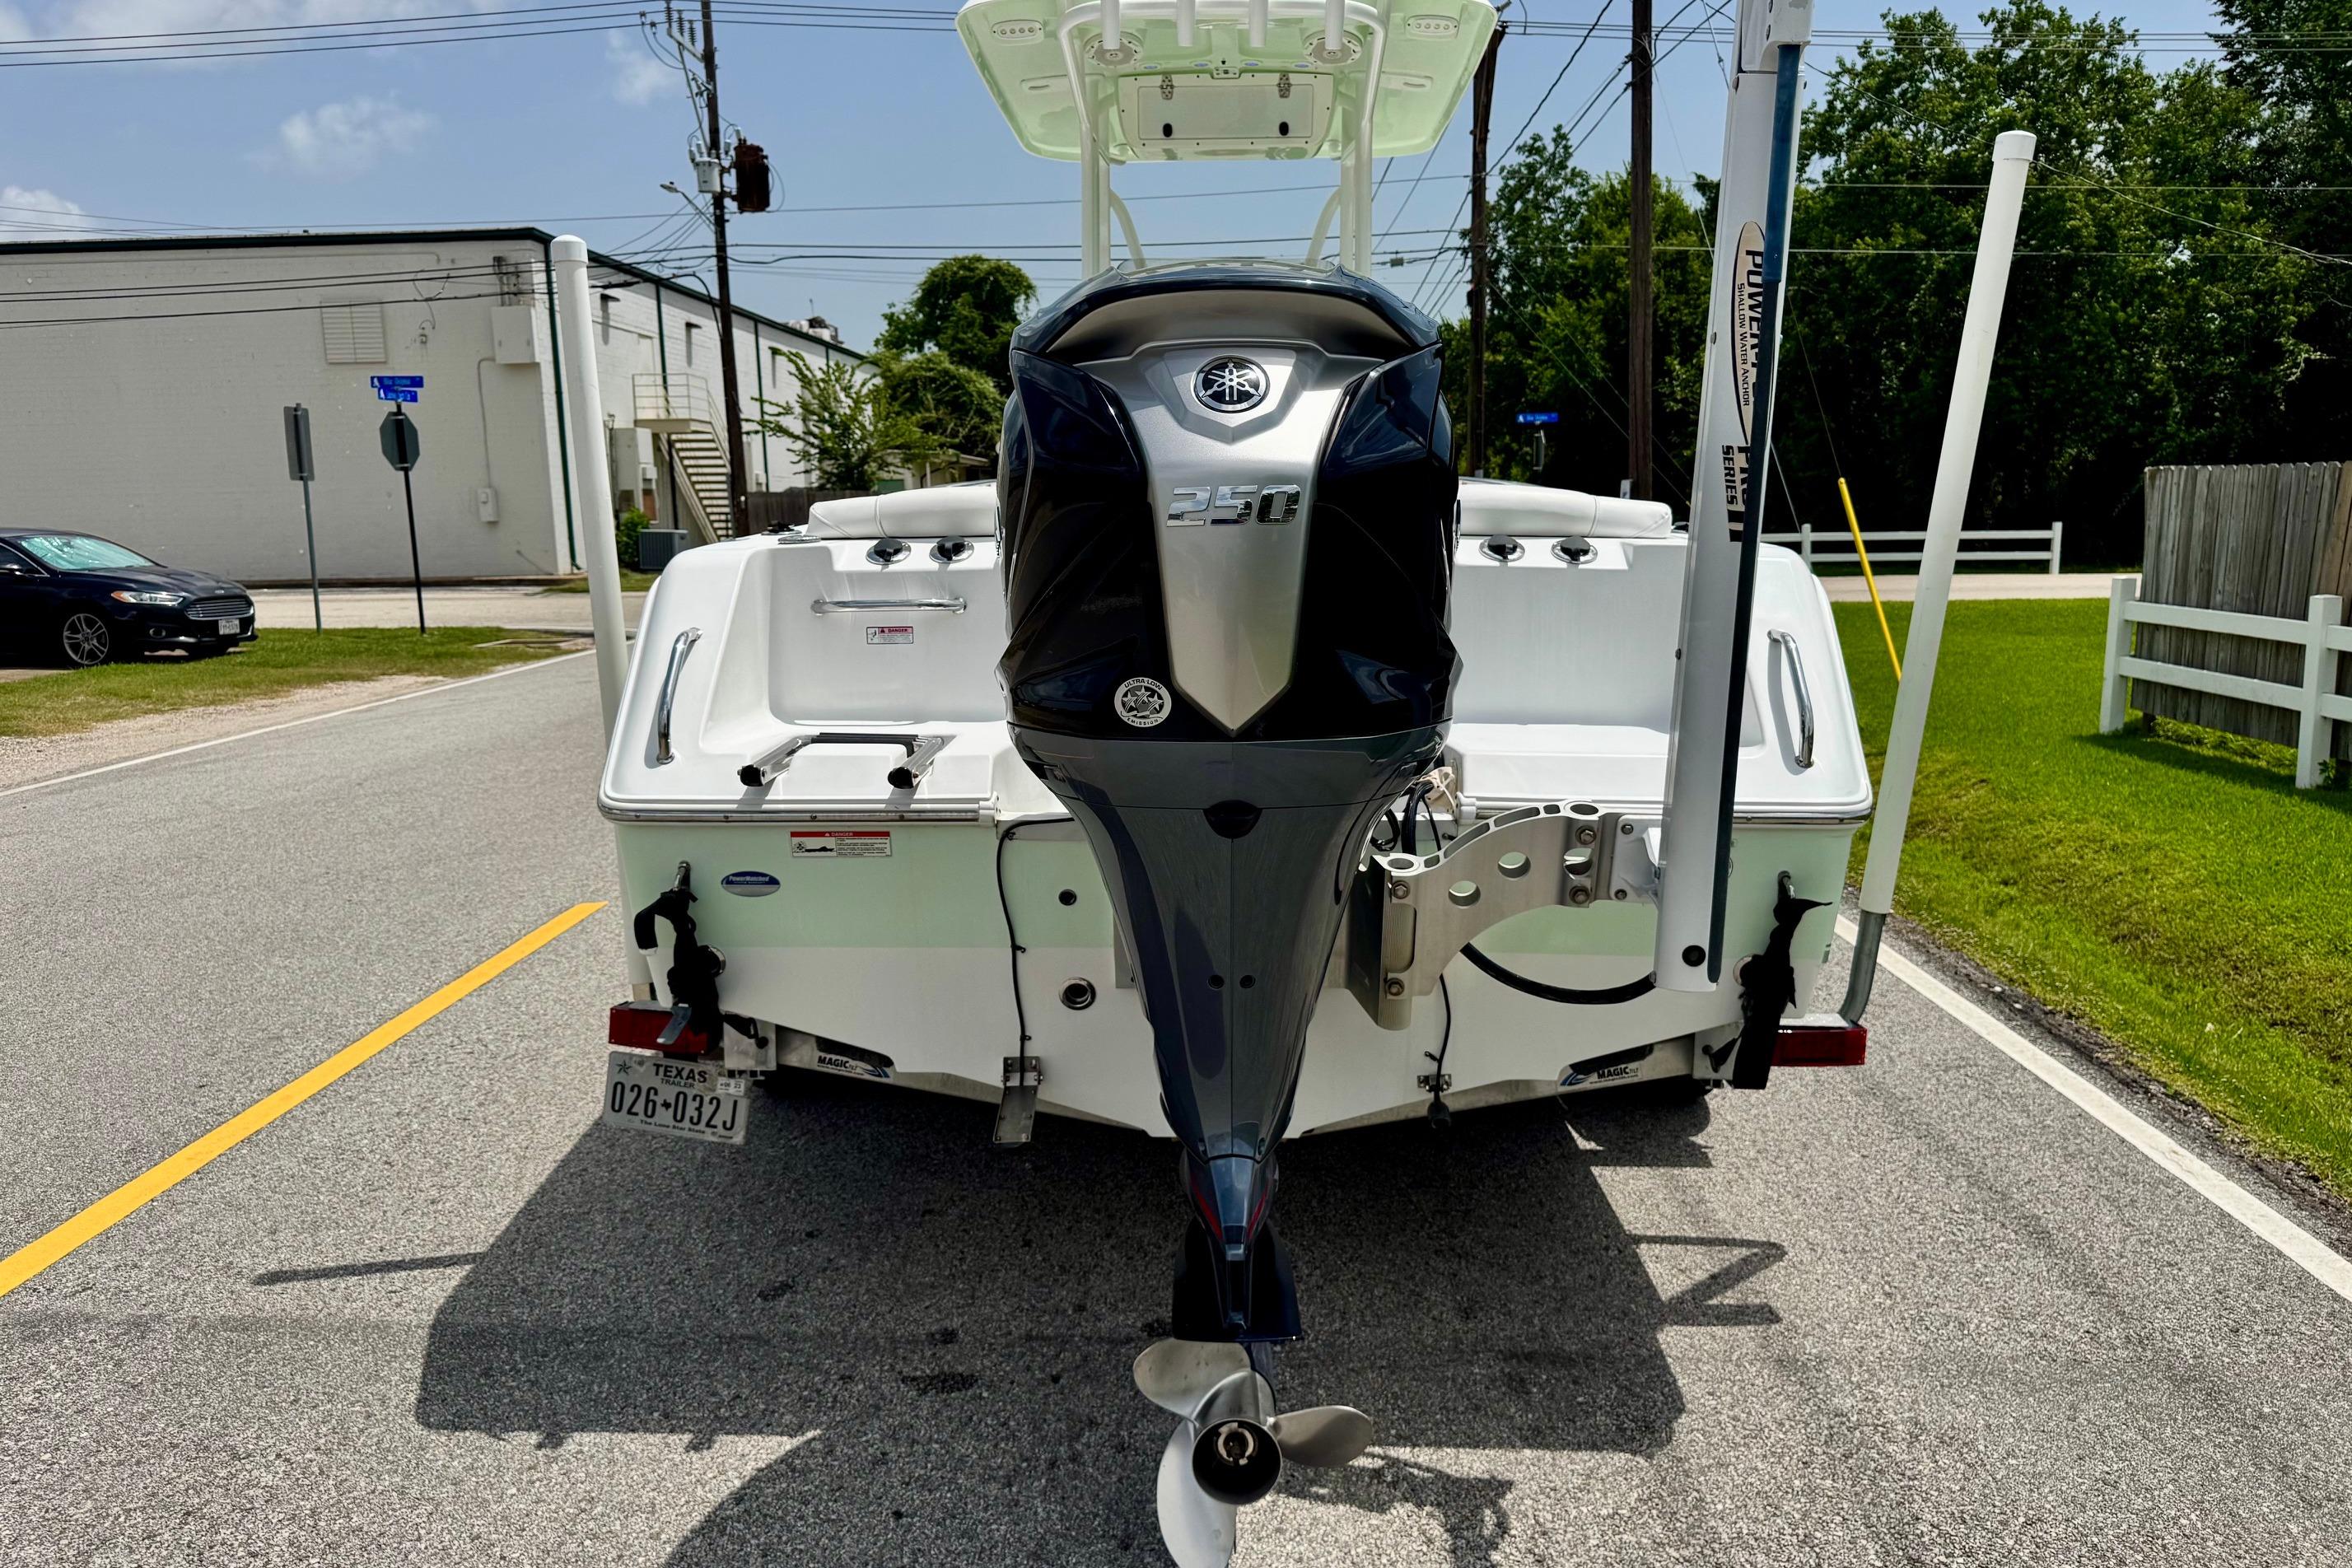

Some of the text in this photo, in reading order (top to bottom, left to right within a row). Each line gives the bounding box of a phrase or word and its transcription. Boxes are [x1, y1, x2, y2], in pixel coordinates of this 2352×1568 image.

[1738, 283, 1750, 406] SHALLOW WATER ANCHOR
[1722, 445, 1738, 505] SERIES
[1166, 484, 1301, 527] 250
[1127, 717, 1159, 726] EMISSION
[817, 1055, 849, 1069] MAGIC
[653, 1063, 708, 1083] TEXAS
[1596, 1066, 1630, 1080] MAGIC
[660, 1078, 696, 1089] TRAILER
